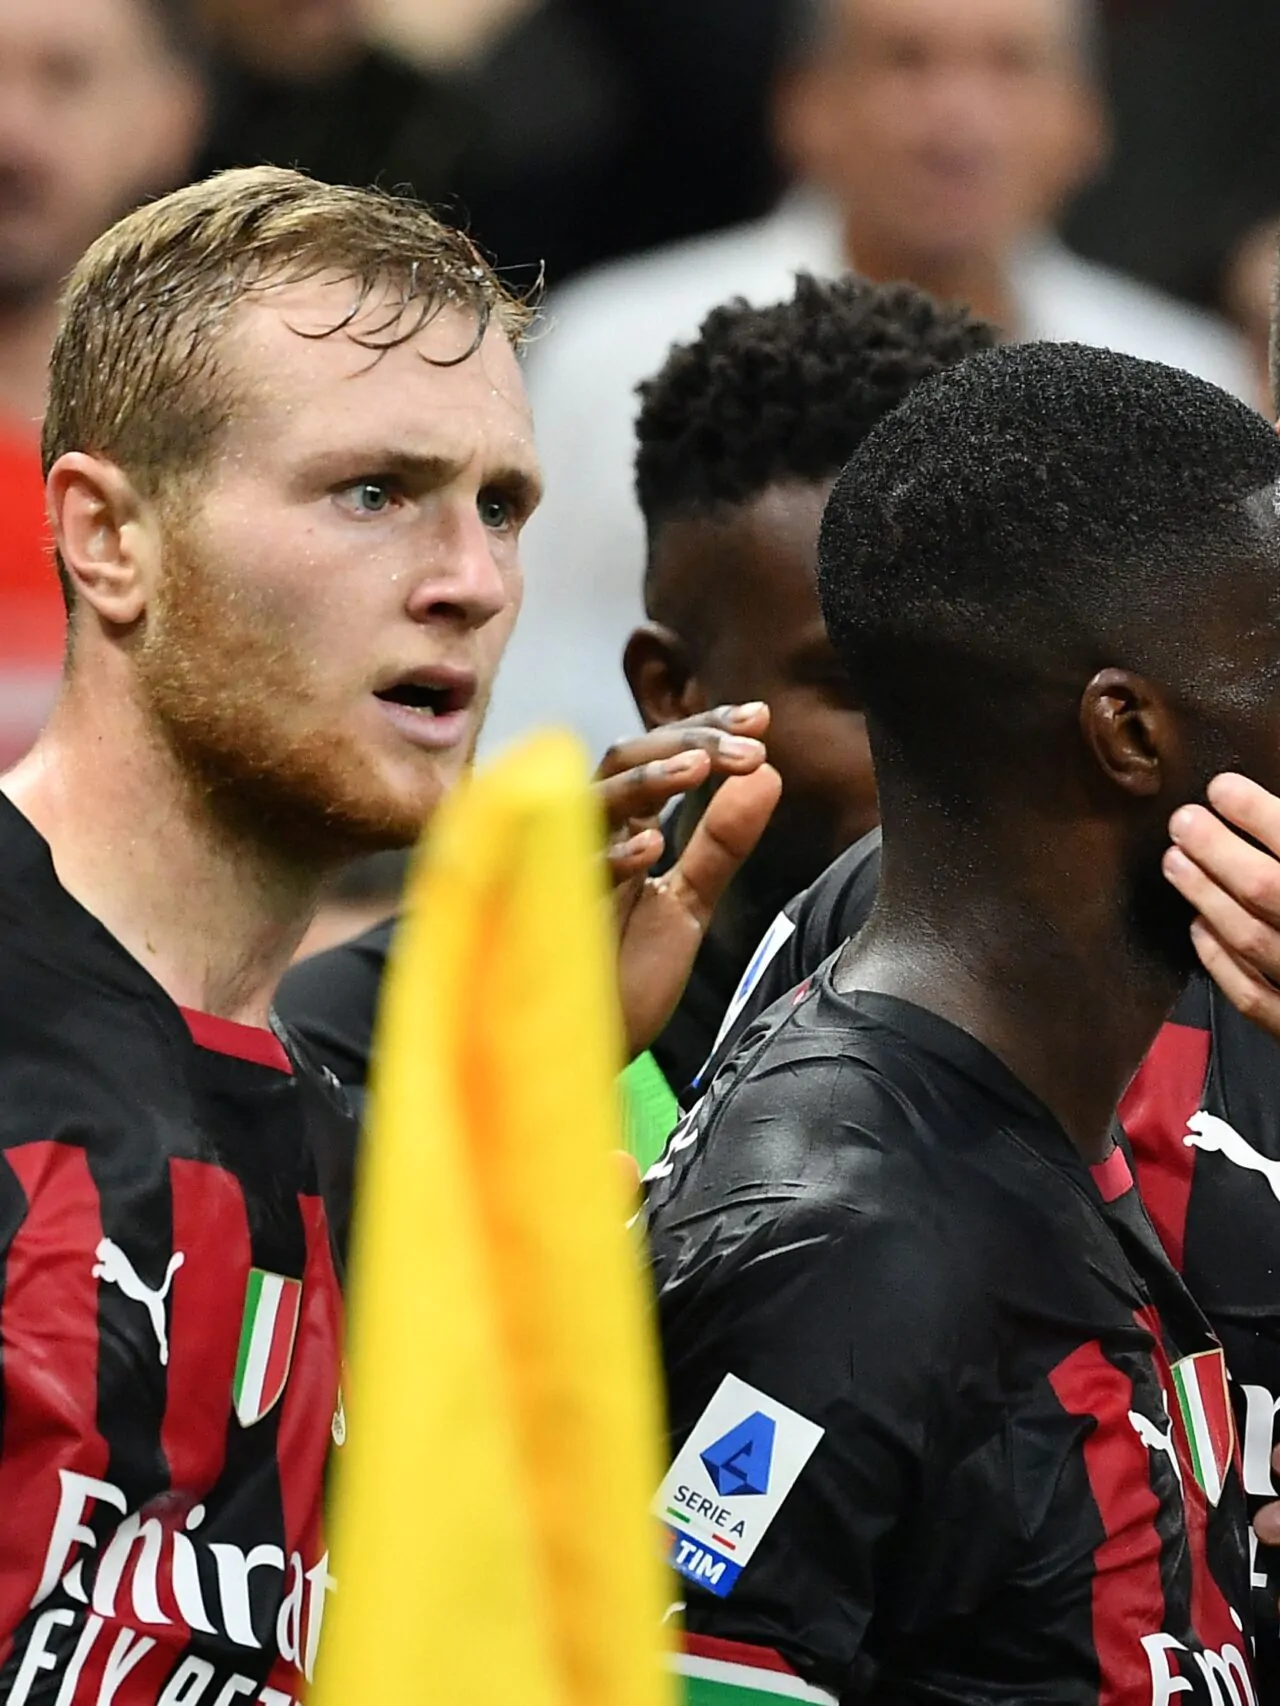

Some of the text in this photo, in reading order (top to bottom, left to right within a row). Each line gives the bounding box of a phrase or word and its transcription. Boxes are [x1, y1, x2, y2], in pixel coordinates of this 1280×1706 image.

[673, 1485, 746, 1538] SERIE A
[30, 1468, 338, 1684] Emirat
[676, 1539, 727, 1585] TIM
